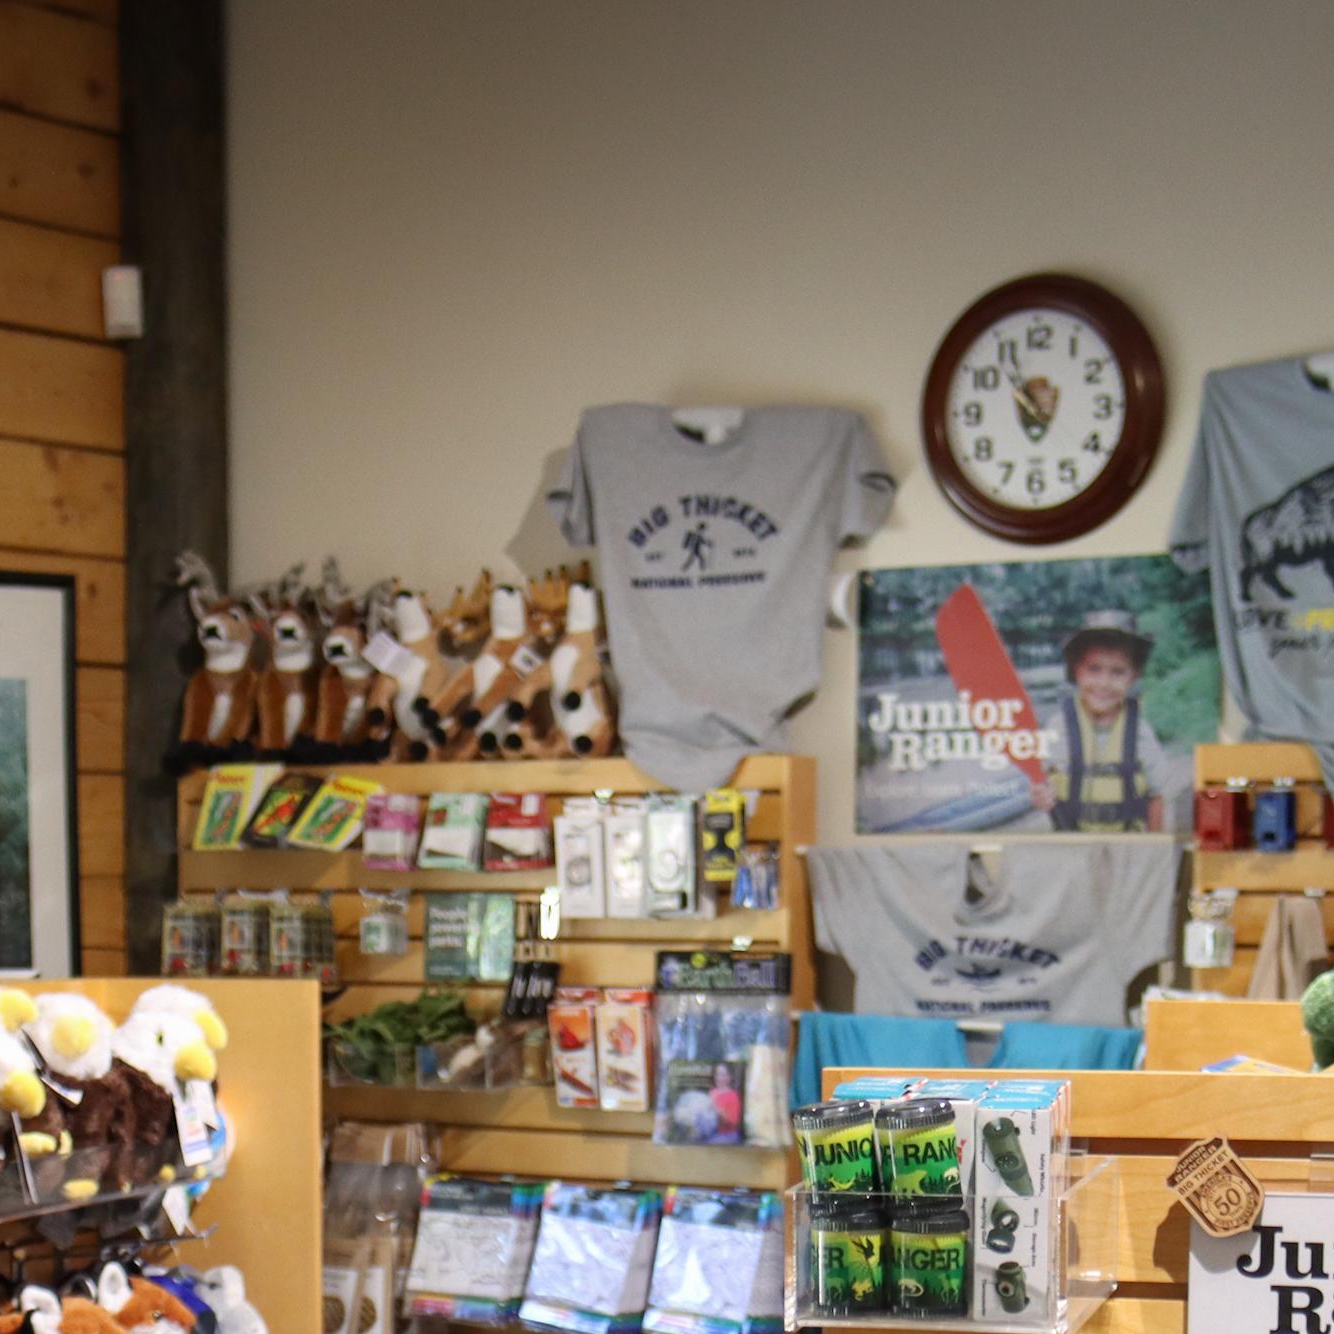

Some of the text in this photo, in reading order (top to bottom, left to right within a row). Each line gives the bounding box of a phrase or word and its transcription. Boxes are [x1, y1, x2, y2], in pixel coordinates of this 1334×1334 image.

[1026, 325, 1054, 350] 12
[1069, 335, 1077, 357] 1
[974, 366, 1000, 391] 10
[1085, 359, 1102, 384] 2
[964, 402, 982, 426] 9
[1094, 393, 1112, 419] 3
[974, 437, 993, 461] 8
[1083, 432, 1101, 453] 4
[998, 462, 1014, 484] 7
[1027, 469, 1044, 493] 6
[1058, 460, 1077, 483] 5
[679, 495, 778, 541] THICKET
[869, 692, 1024, 732] Junior
[888, 729, 1058, 772] Ranger
[813, 1135, 874, 1167] JUNIO
[1178, 1150, 1228, 1195] BIG THICKET
[1214, 1188, 1241, 1216] 50
